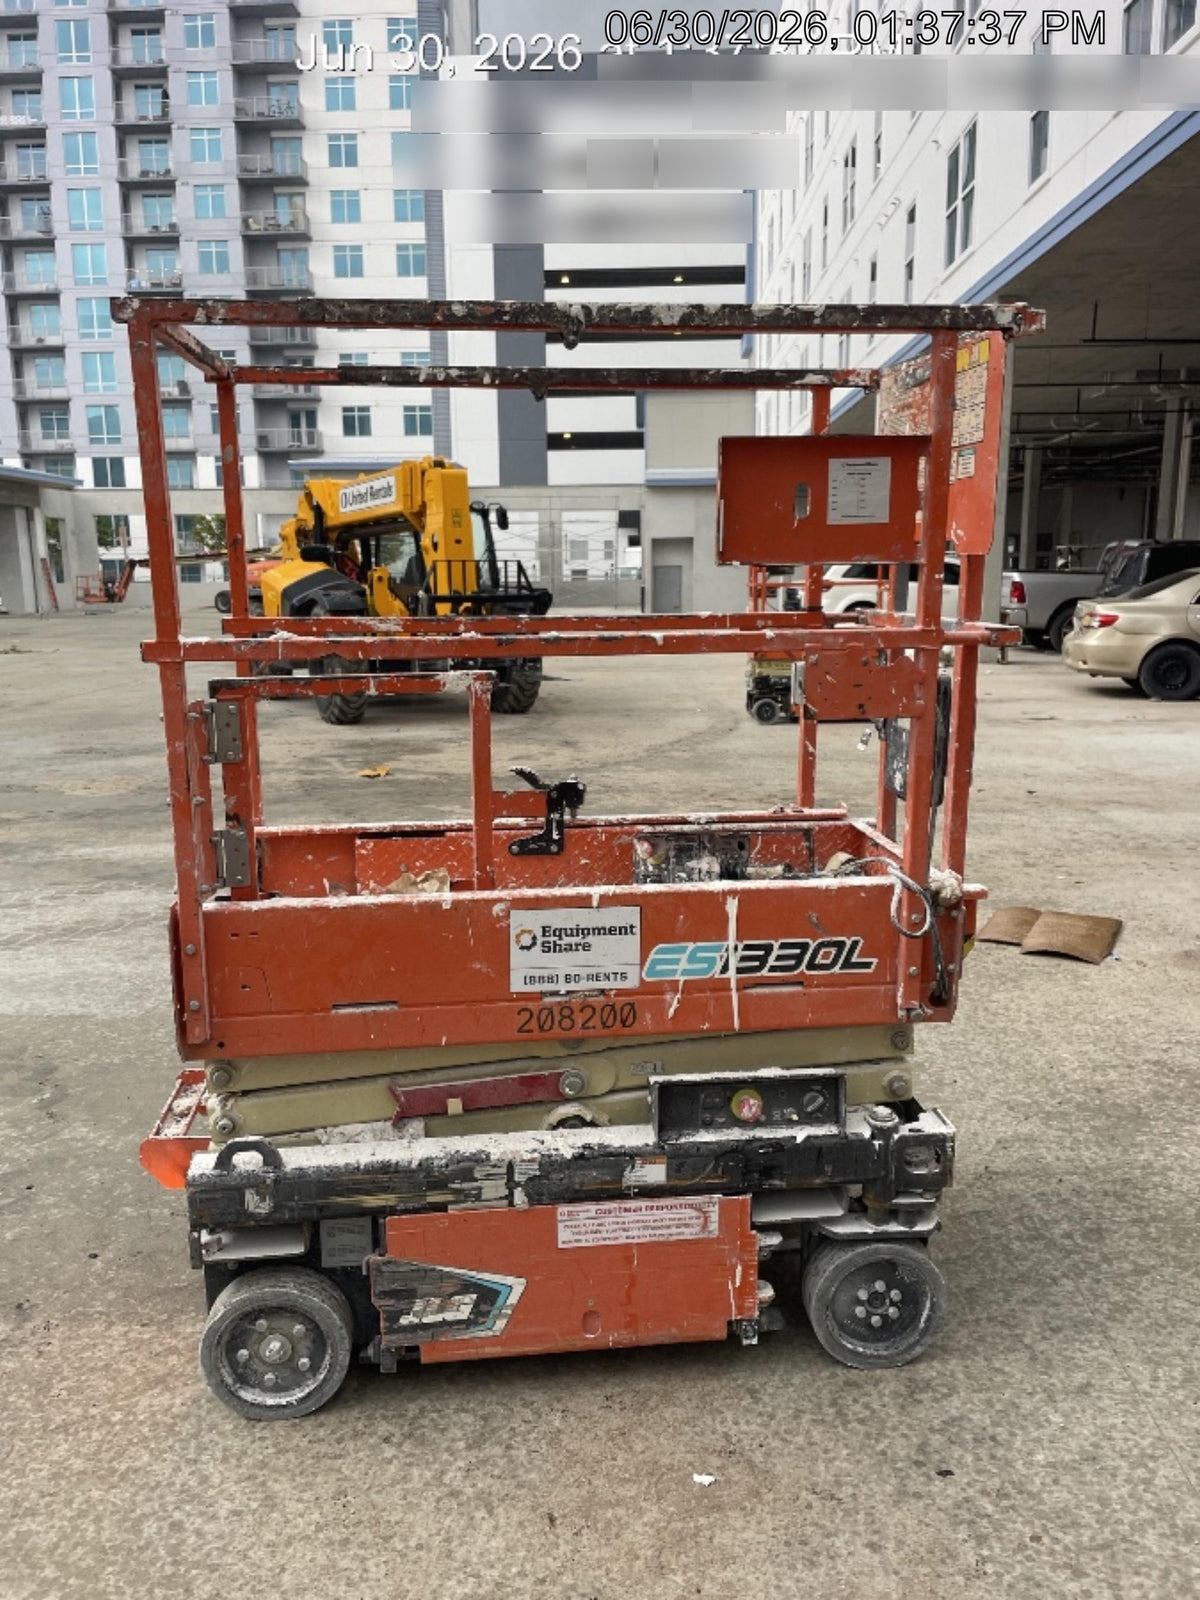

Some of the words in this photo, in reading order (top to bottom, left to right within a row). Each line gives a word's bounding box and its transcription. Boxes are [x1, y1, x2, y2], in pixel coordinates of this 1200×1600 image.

[348, 486, 369, 507] United
[369, 481, 393, 501] Rentals
[541, 924, 636, 941] Equipment
[541, 940, 592, 953] Share
[516, 1002, 637, 1033] 208200
